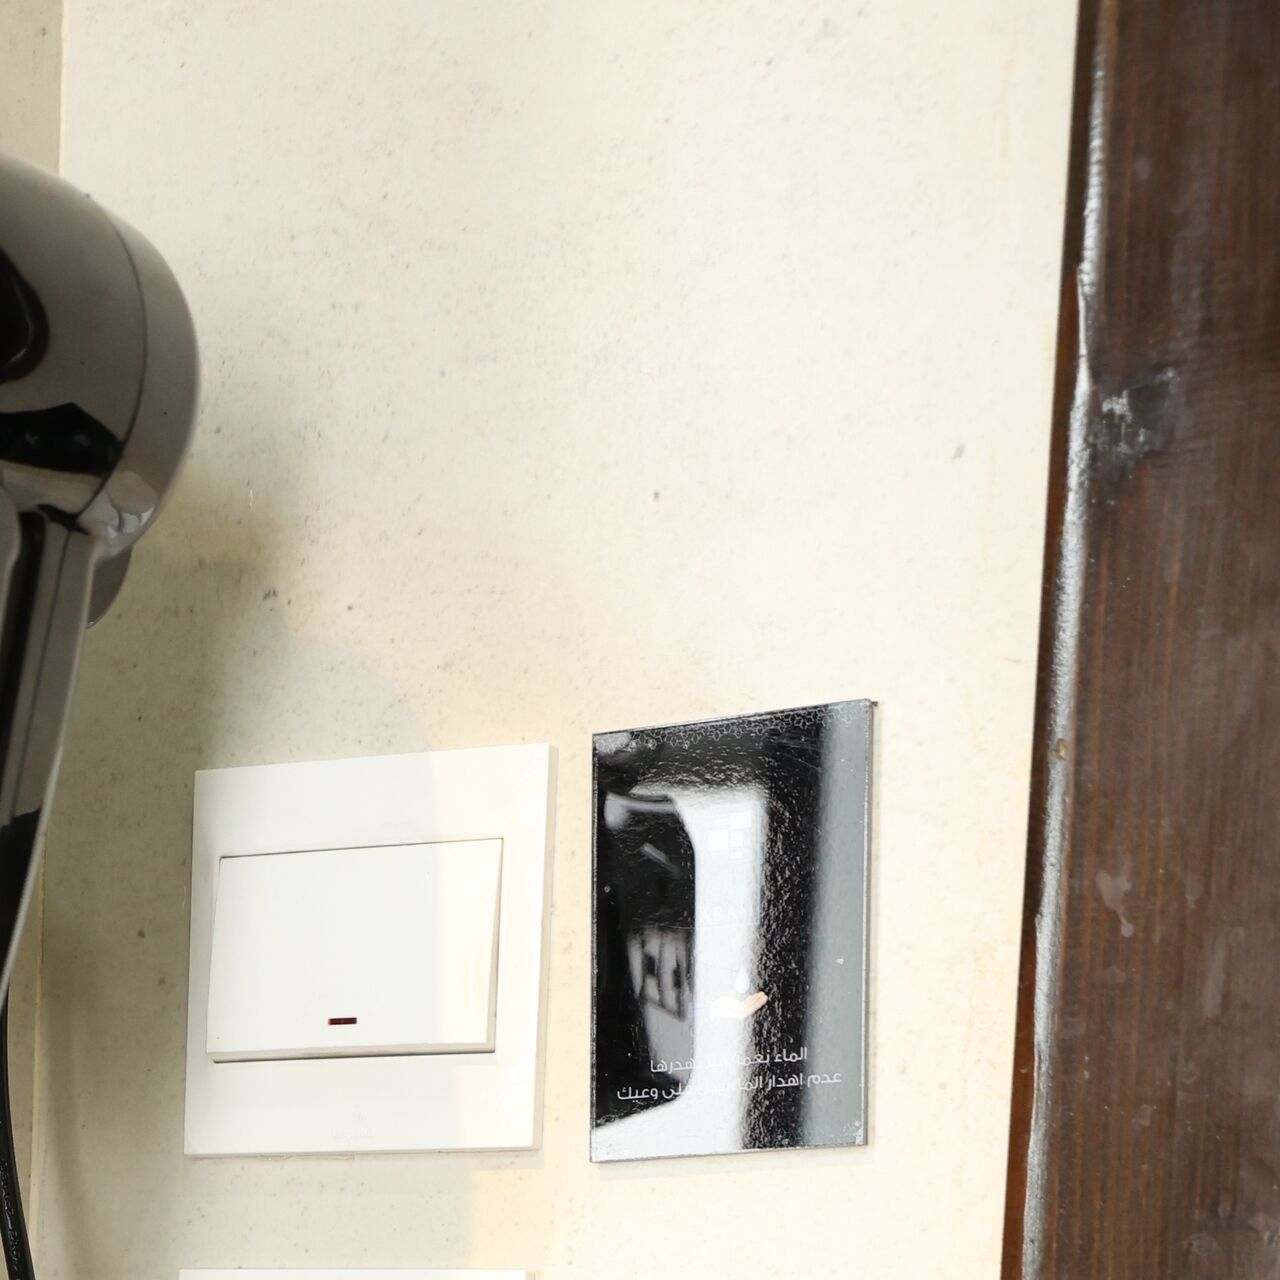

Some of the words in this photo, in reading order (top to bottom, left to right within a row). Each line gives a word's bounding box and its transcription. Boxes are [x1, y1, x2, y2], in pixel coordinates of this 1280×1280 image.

[774, 1046, 808, 1063] الماء
[650, 1058, 700, 1075] هدرها
[807, 1072, 842, 1088] عدم
[617, 1086, 659, 1103] وعيك
